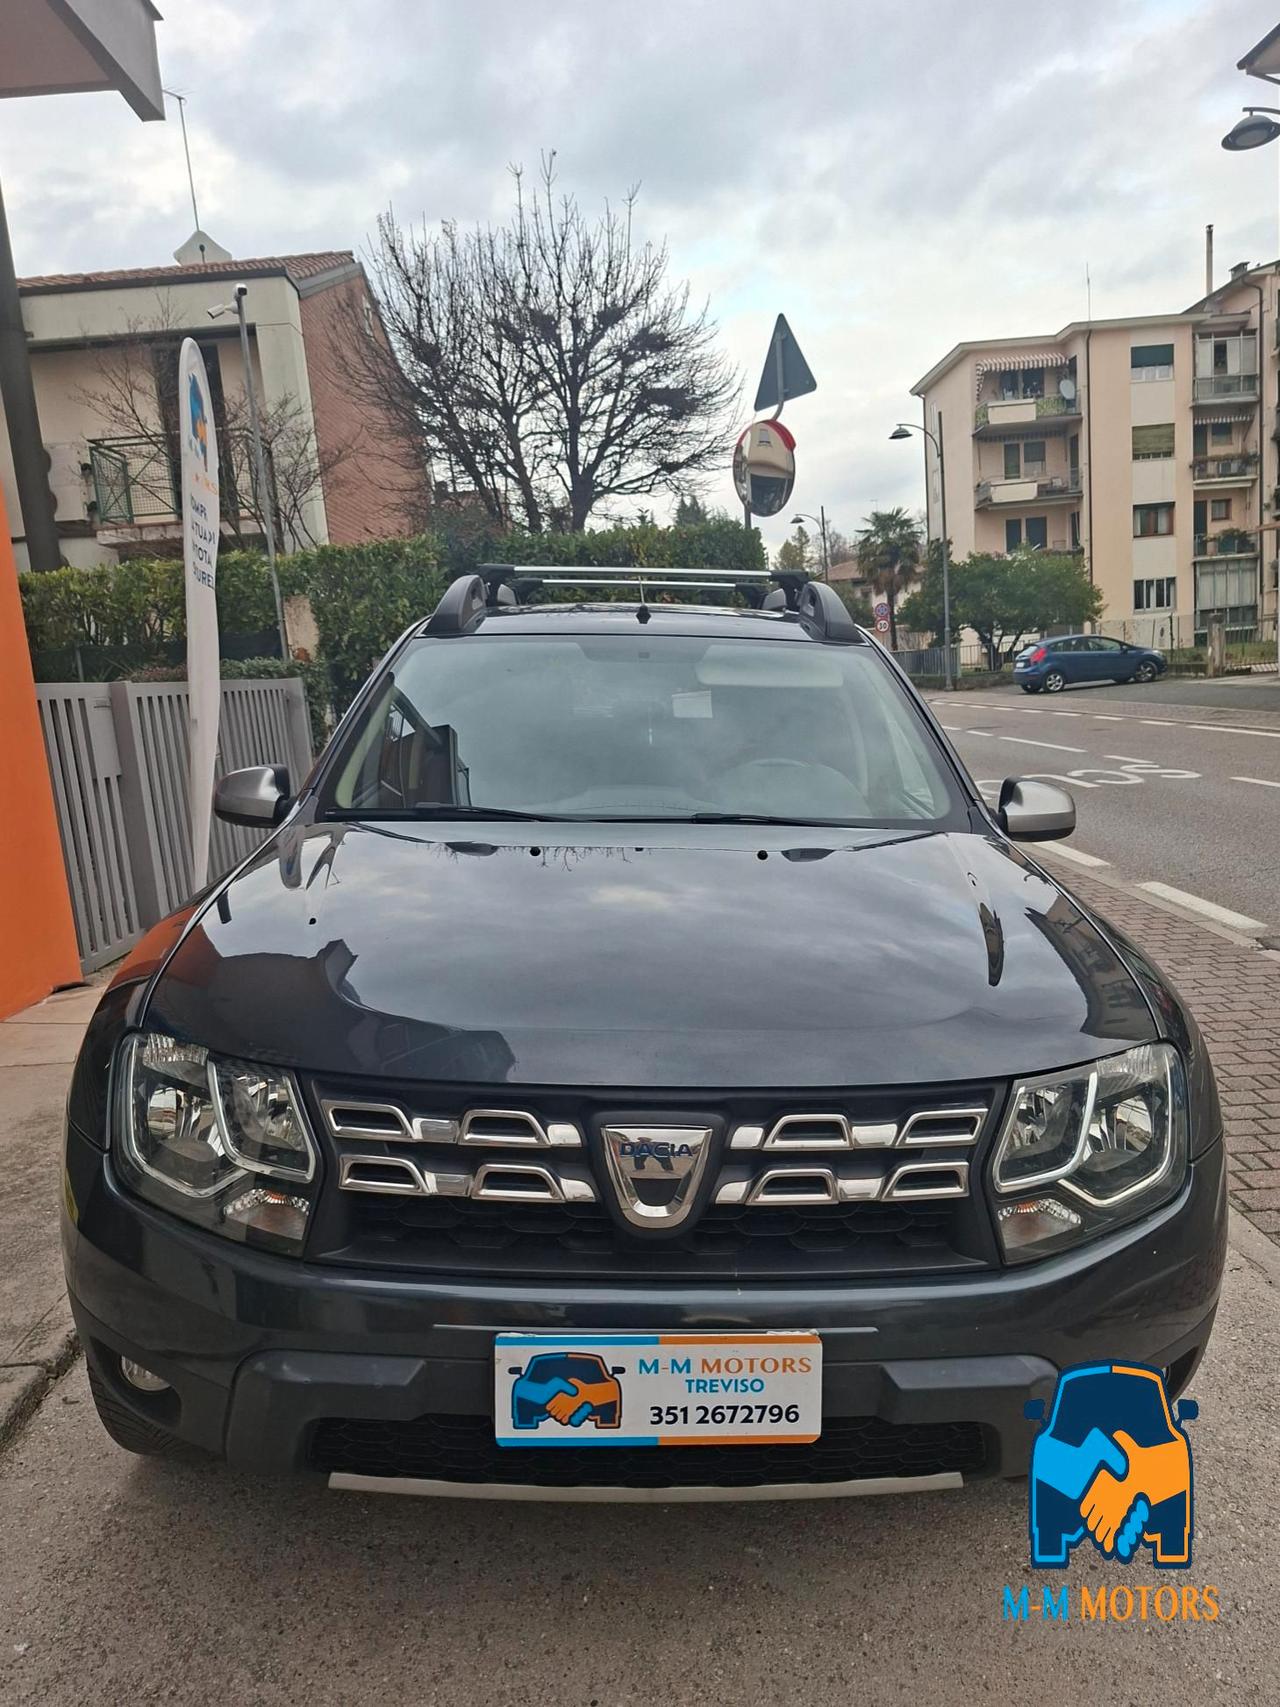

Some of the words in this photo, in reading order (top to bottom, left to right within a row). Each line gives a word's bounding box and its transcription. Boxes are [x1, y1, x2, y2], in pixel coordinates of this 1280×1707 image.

[620, 1142, 693, 1157] DACIA
[638, 1357, 691, 1375] M-M
[701, 1356, 812, 1374] MOTORS
[685, 1378, 764, 1394] TREVISO
[650, 1405, 689, 1425] 351
[696, 1404, 800, 1424] 2672796
